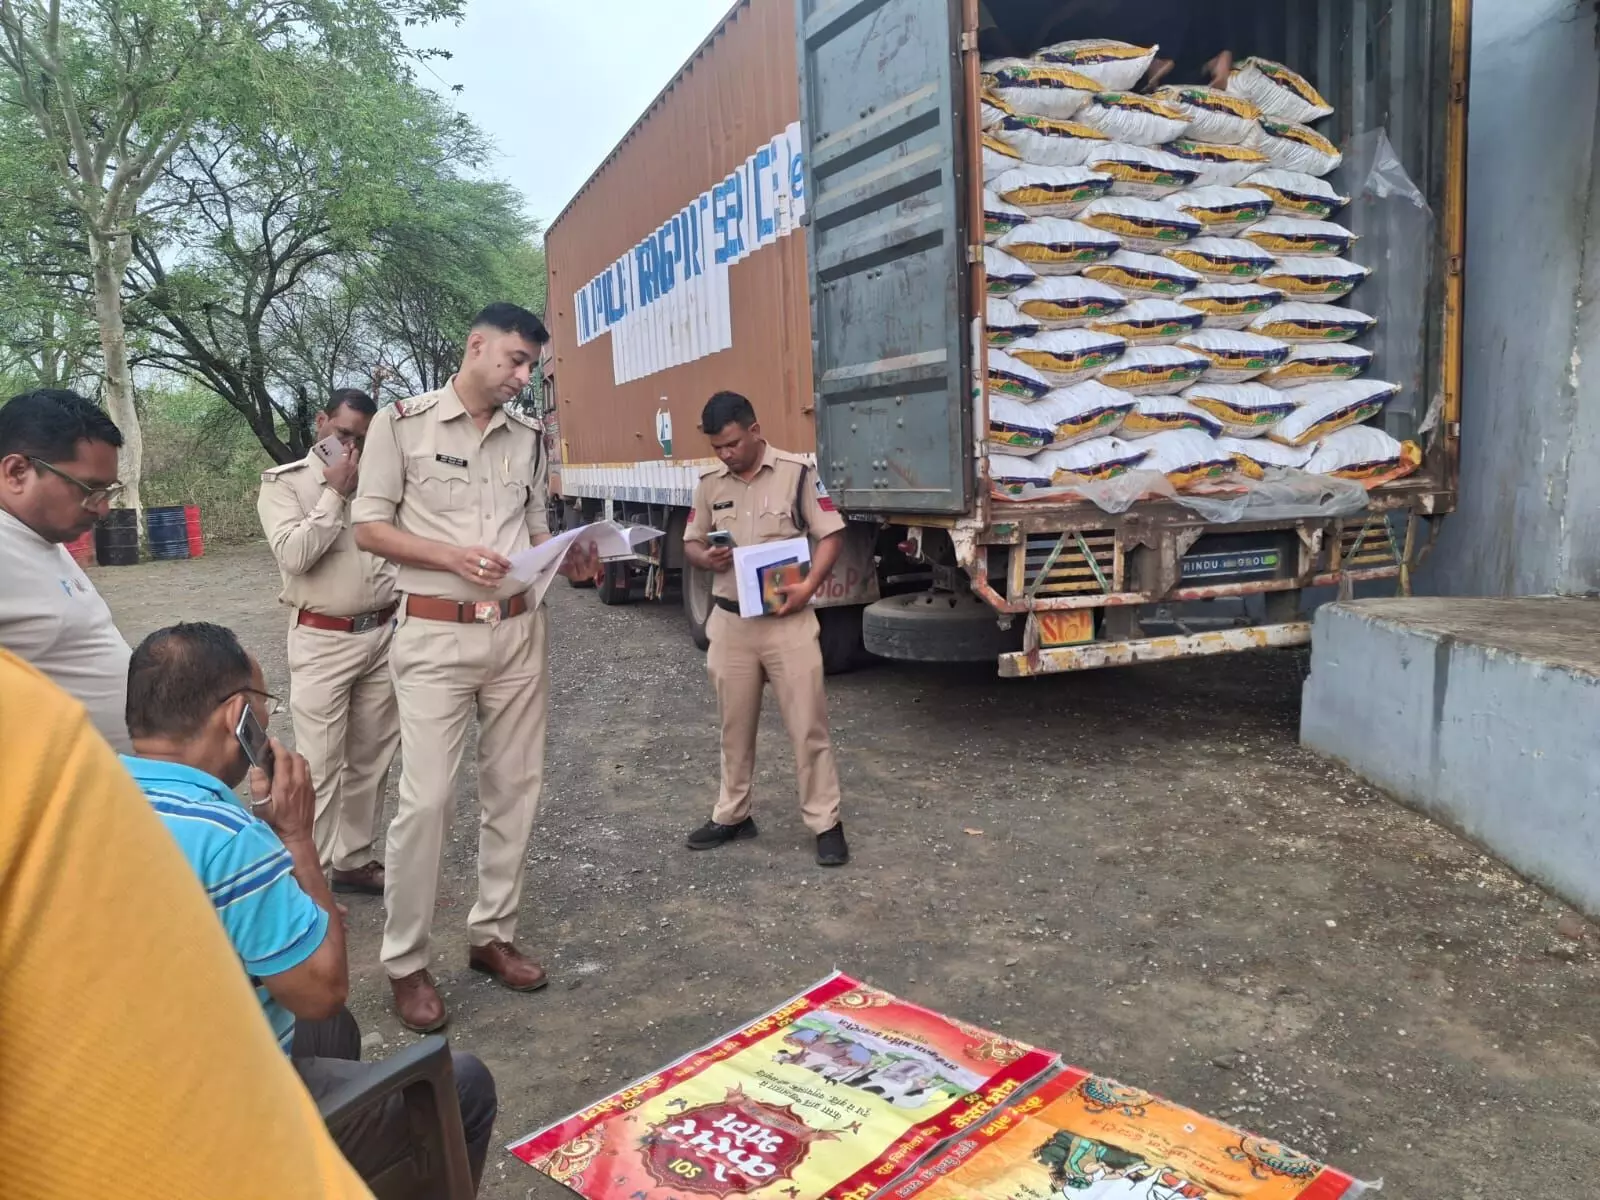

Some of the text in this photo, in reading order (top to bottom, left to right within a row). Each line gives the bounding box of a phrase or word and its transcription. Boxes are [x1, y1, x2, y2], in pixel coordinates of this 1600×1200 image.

[950, 1078, 1021, 1129] केसर भोग
[662, 1119, 777, 1182] केसर
[712, 1113, 784, 1153] भोग
[668, 1158, 702, 1179] SOI
